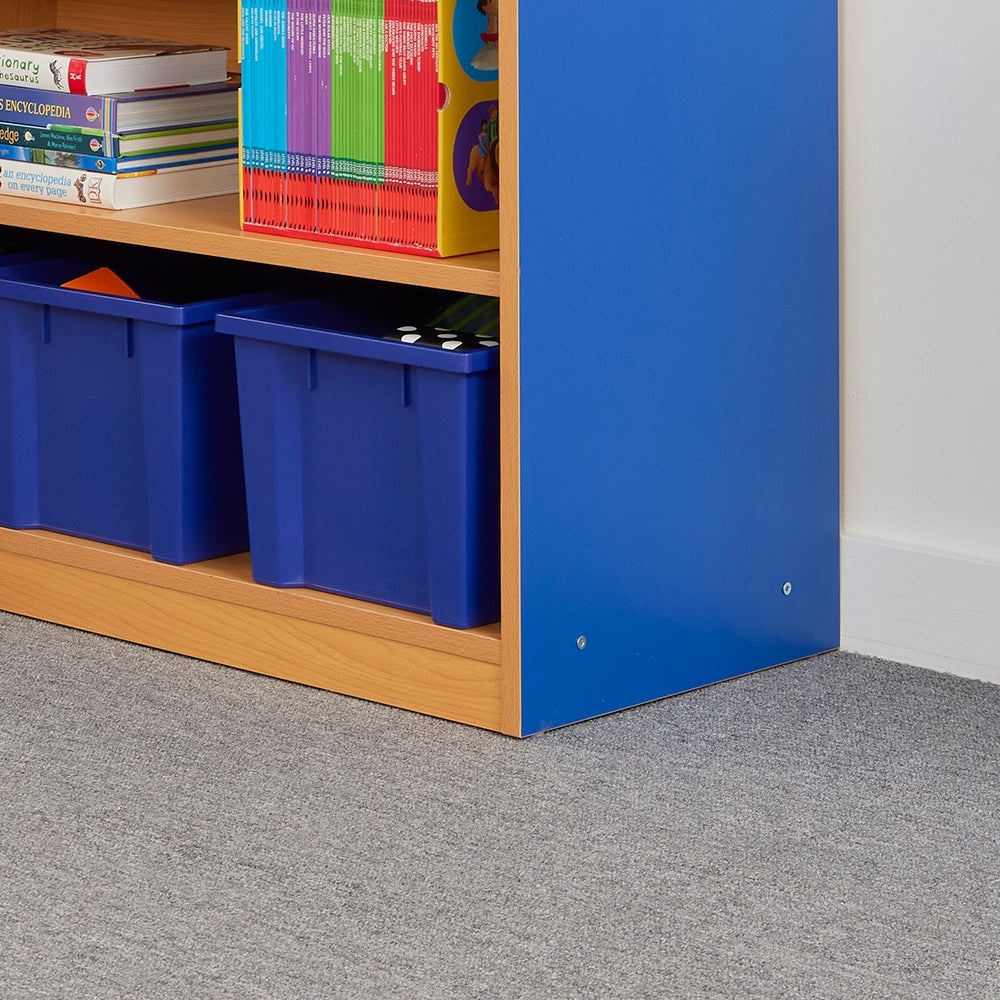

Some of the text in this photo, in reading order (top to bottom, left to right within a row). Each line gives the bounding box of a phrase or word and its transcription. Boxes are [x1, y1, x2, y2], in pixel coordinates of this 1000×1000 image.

[5, 98, 71, 119] ENCYCLOPEDIA
[3, 170, 72, 187] an encyclopedia
[7, 180, 67, 198] on every page
[88, 177, 103, 205] DK
